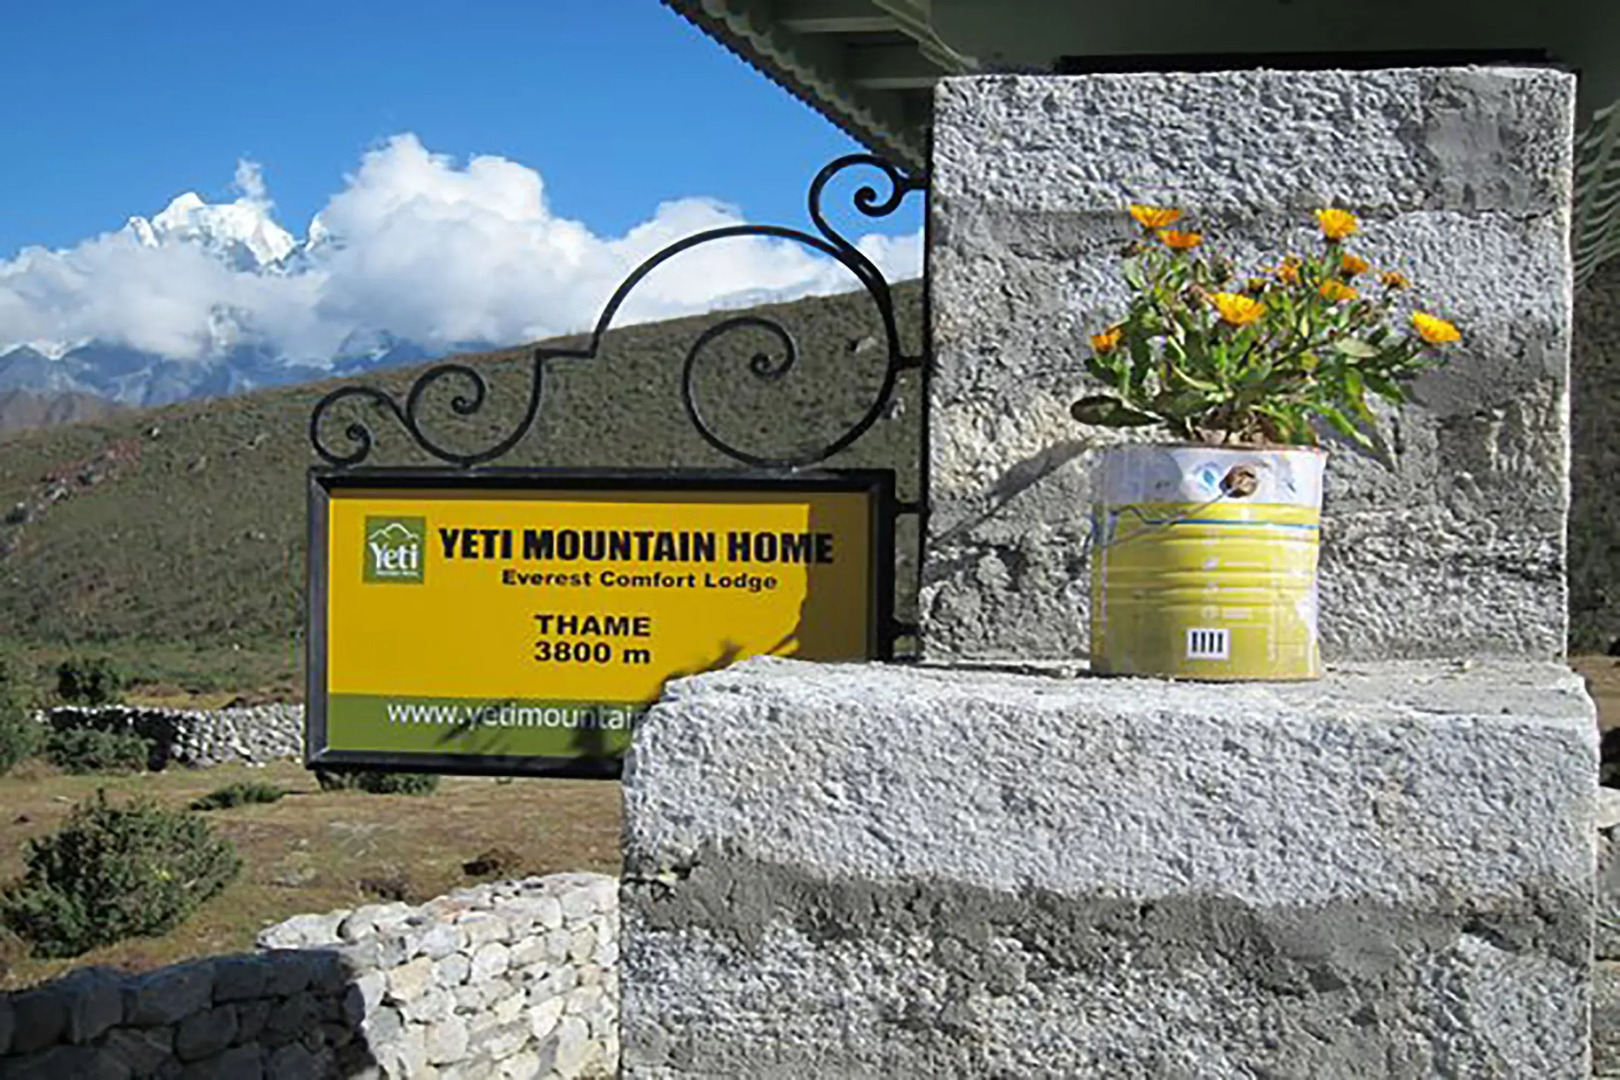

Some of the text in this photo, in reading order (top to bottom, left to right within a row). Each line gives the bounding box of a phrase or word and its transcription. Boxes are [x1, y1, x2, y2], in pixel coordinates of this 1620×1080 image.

[369, 542, 417, 570] Yeti
[438, 528, 834, 564] YETI MOUNTAIN HOME
[502, 569, 777, 592] Everest Comfort Lodge
[533, 614, 651, 637] THAME
[533, 641, 651, 664] 3800 m
